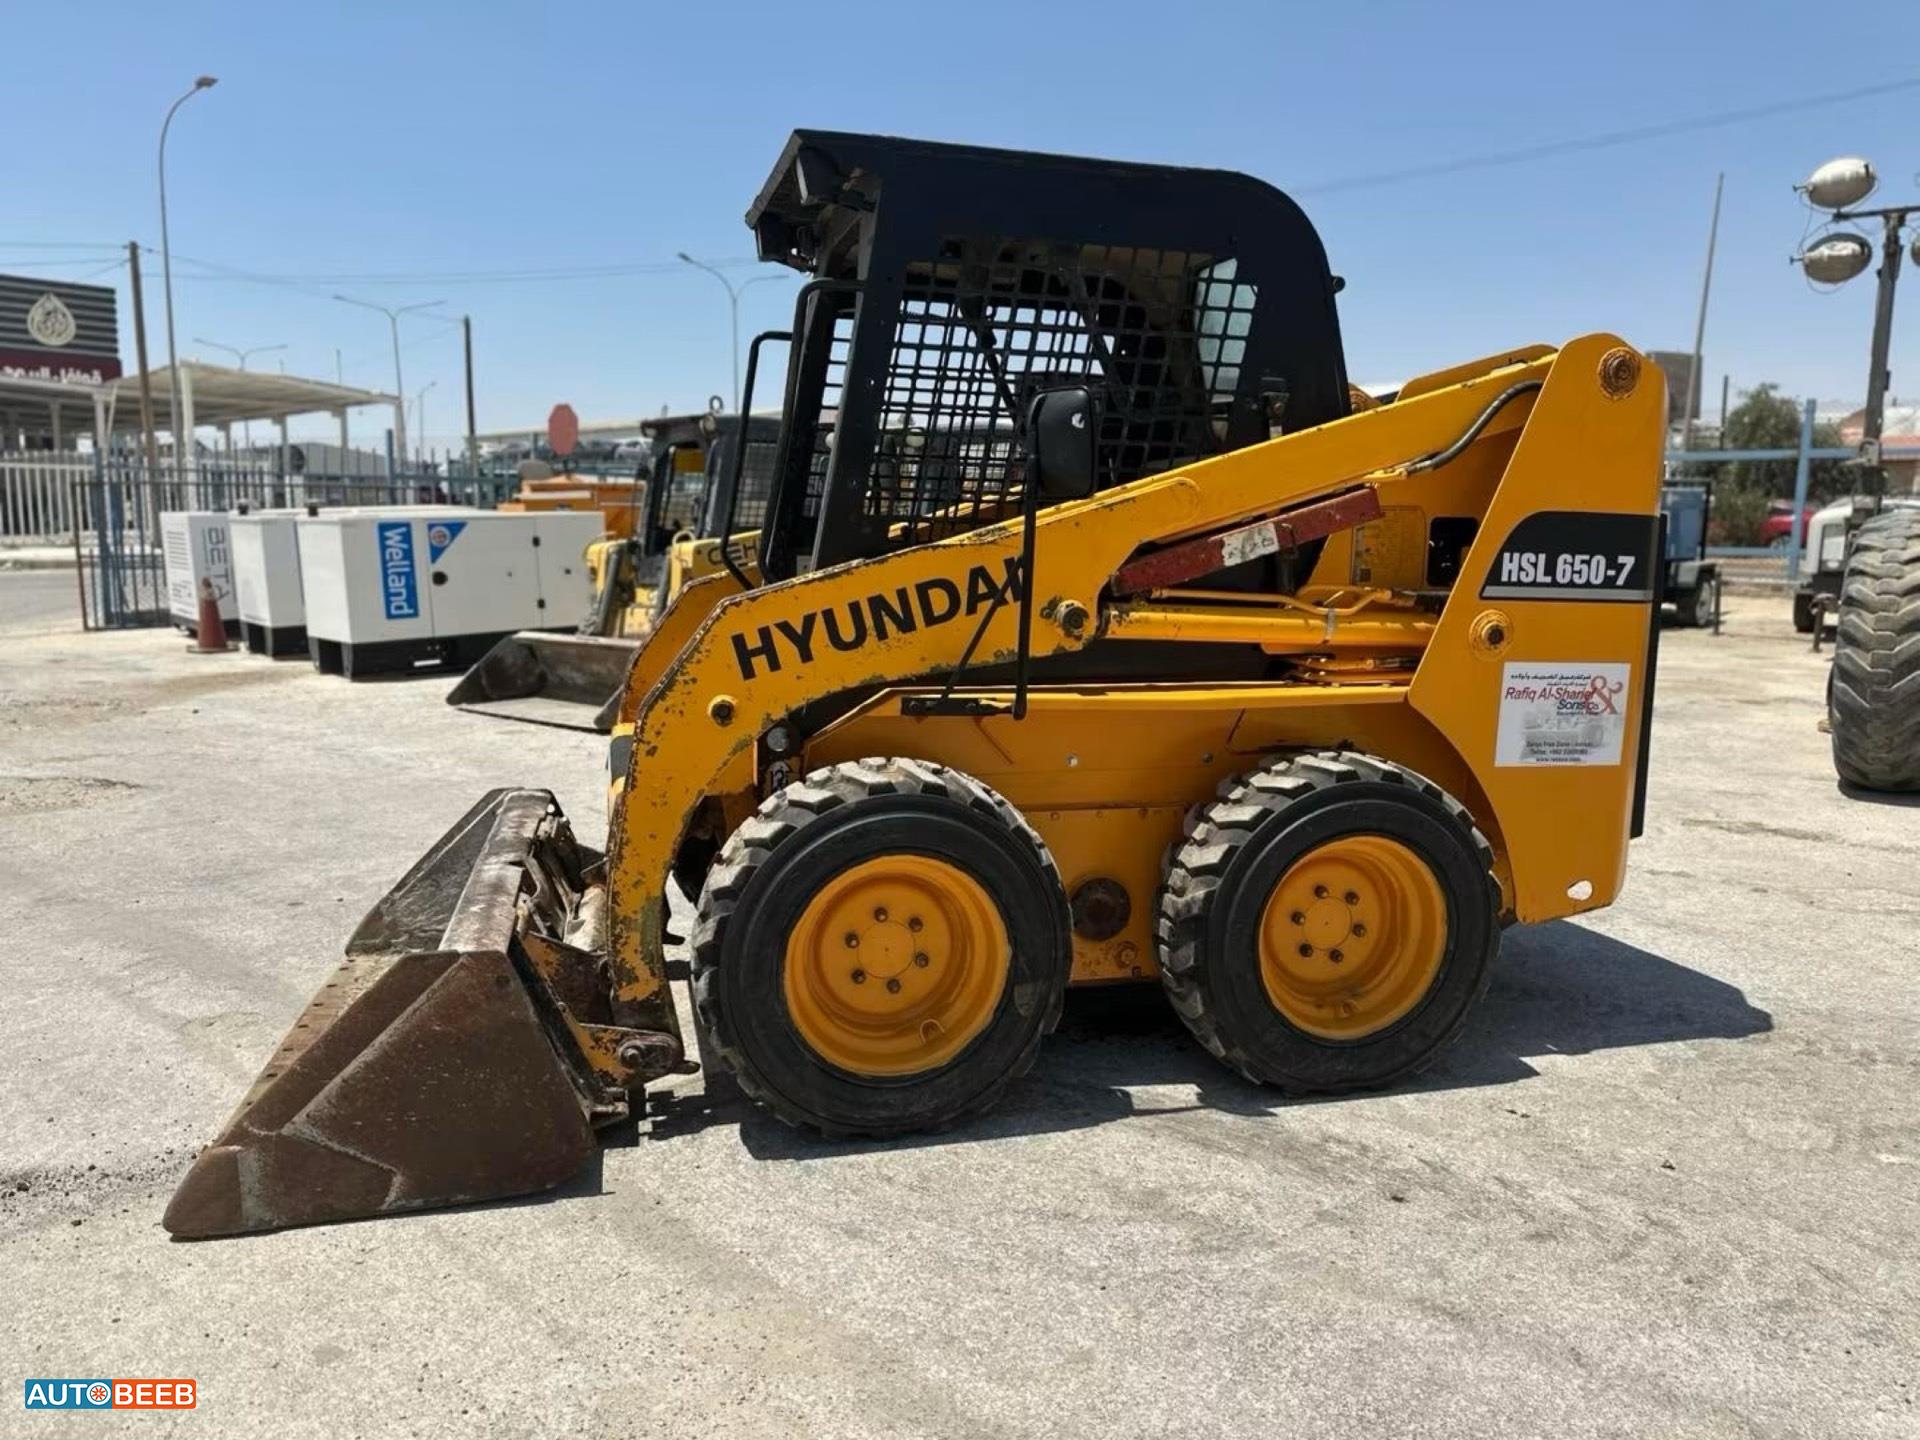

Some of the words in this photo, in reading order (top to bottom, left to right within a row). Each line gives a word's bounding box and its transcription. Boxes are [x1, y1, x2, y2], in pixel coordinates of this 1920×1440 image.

[384, 526, 415, 616] Welland
[1501, 552, 1551, 582] HSL
[1556, 553, 1635, 586] 650-7
[1505, 686, 1536, 702] Rafiq
